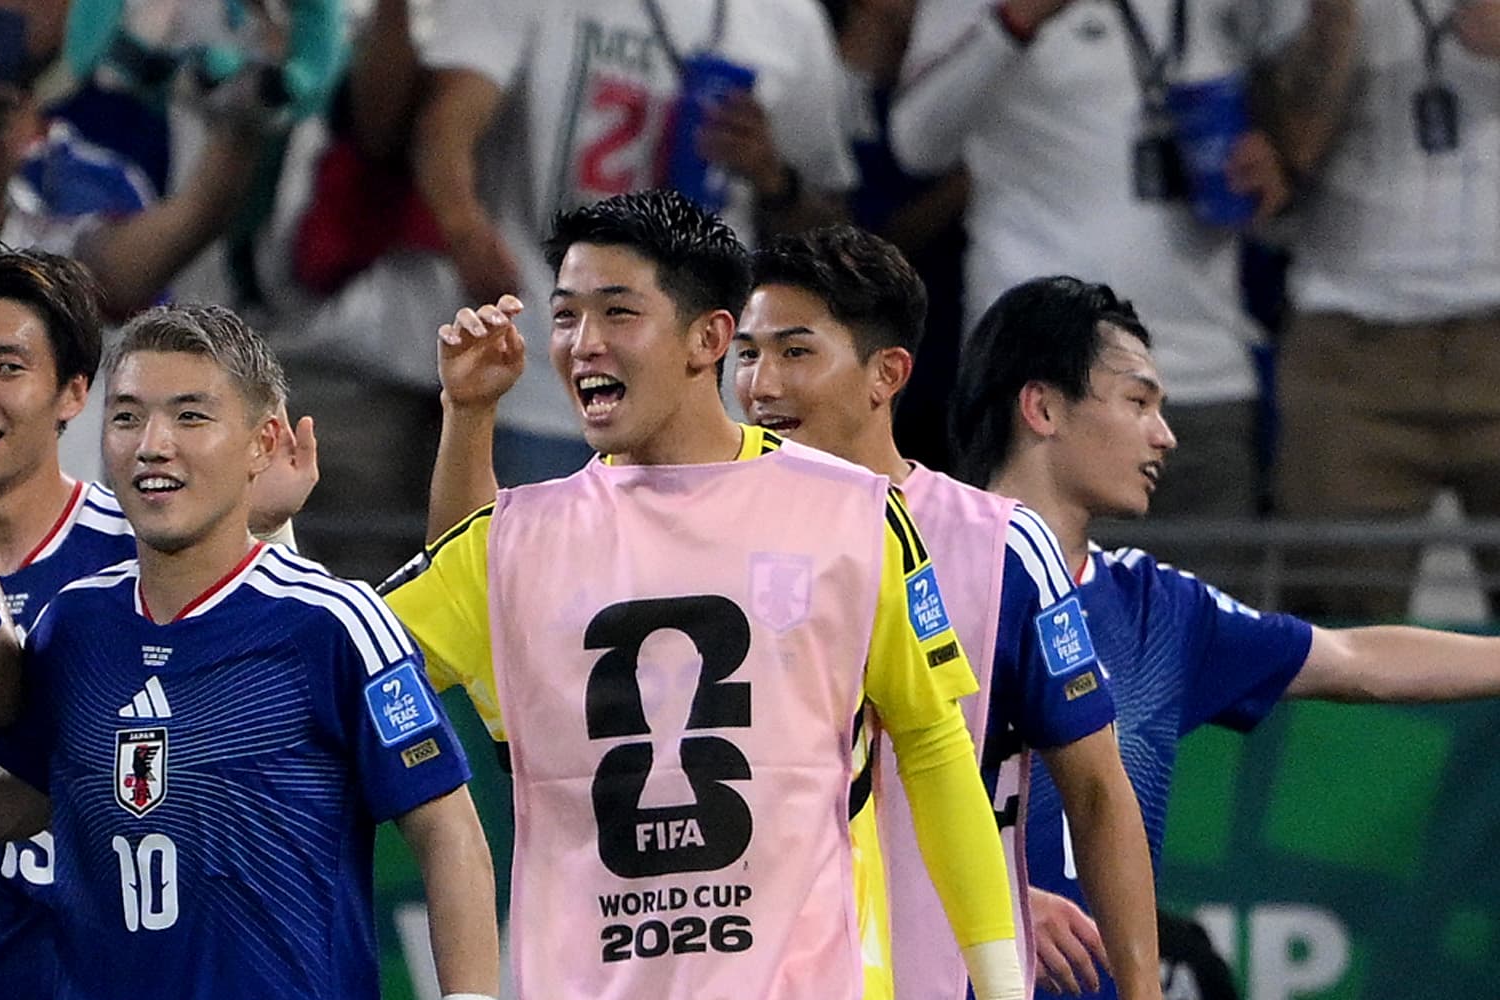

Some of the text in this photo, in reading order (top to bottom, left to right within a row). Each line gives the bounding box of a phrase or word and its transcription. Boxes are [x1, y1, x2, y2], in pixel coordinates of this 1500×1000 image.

[389, 705, 420, 727] PEACE
[637, 819, 705, 851] FIFA
[113, 834, 178, 931] 10
[599, 885, 752, 918] WORLD CUP
[601, 915, 753, 963] 2026
